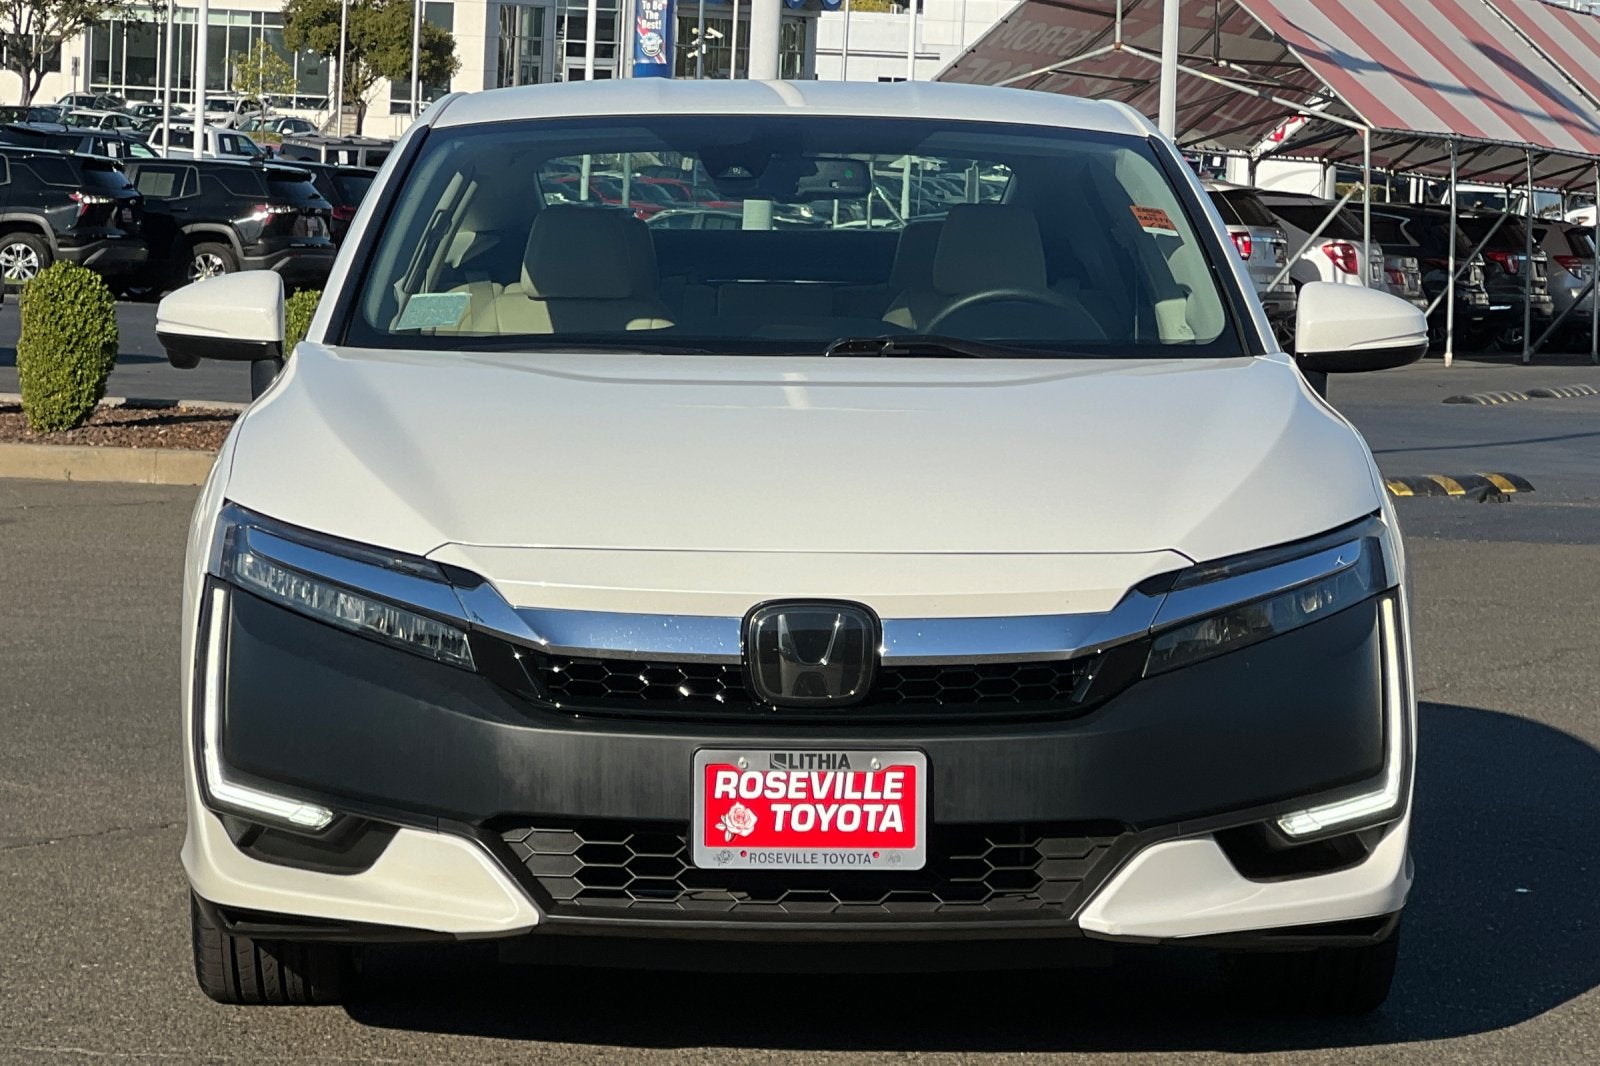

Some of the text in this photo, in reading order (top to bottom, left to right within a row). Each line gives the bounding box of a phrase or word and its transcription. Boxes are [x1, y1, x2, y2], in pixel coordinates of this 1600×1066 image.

[642, 0, 662, 10] To Be
[645, 10, 659, 19] The
[642, 19, 661, 29] Best!
[788, 753, 851, 770] LITHIA
[714, 771, 905, 800] ROSEVILLE
[770, 803, 904, 833] TOYOTA
[749, 852, 818, 865] ROSEVILLE
[821, 853, 872, 865] TOYOTA
